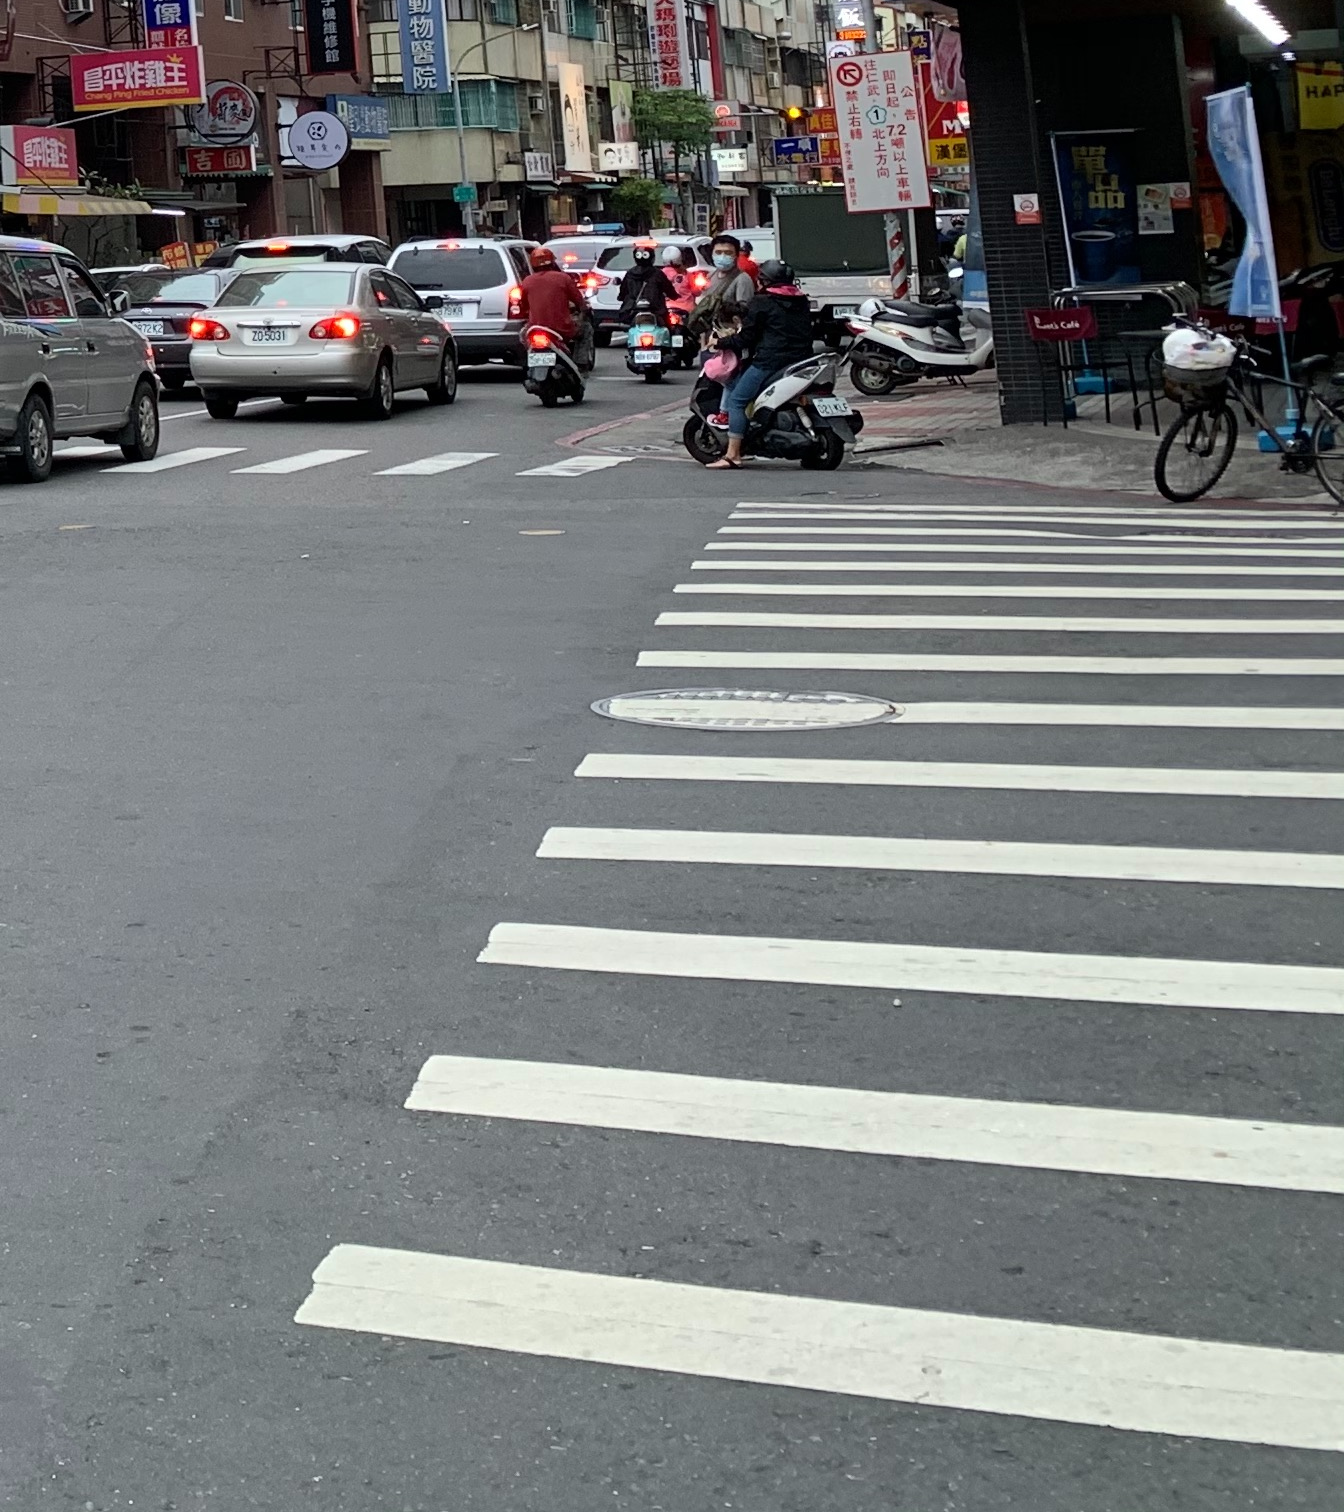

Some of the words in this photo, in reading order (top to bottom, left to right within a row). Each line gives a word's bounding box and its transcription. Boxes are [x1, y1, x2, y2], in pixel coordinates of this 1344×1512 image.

[83, 60, 188, 93] 昌平炸雞王
[84, 91, 112, 101] Chang
[114, 90, 132, 100] Ping
[133, 89, 155, 98] Fried
[155, 86, 190, 96] Chicken
[845, 89, 863, 141] 禁止右轉
[900, 85, 917, 121] 公告
[22, 134, 70, 170] 昌平炸雞王
[935, 143, 969, 161] 漢堡
